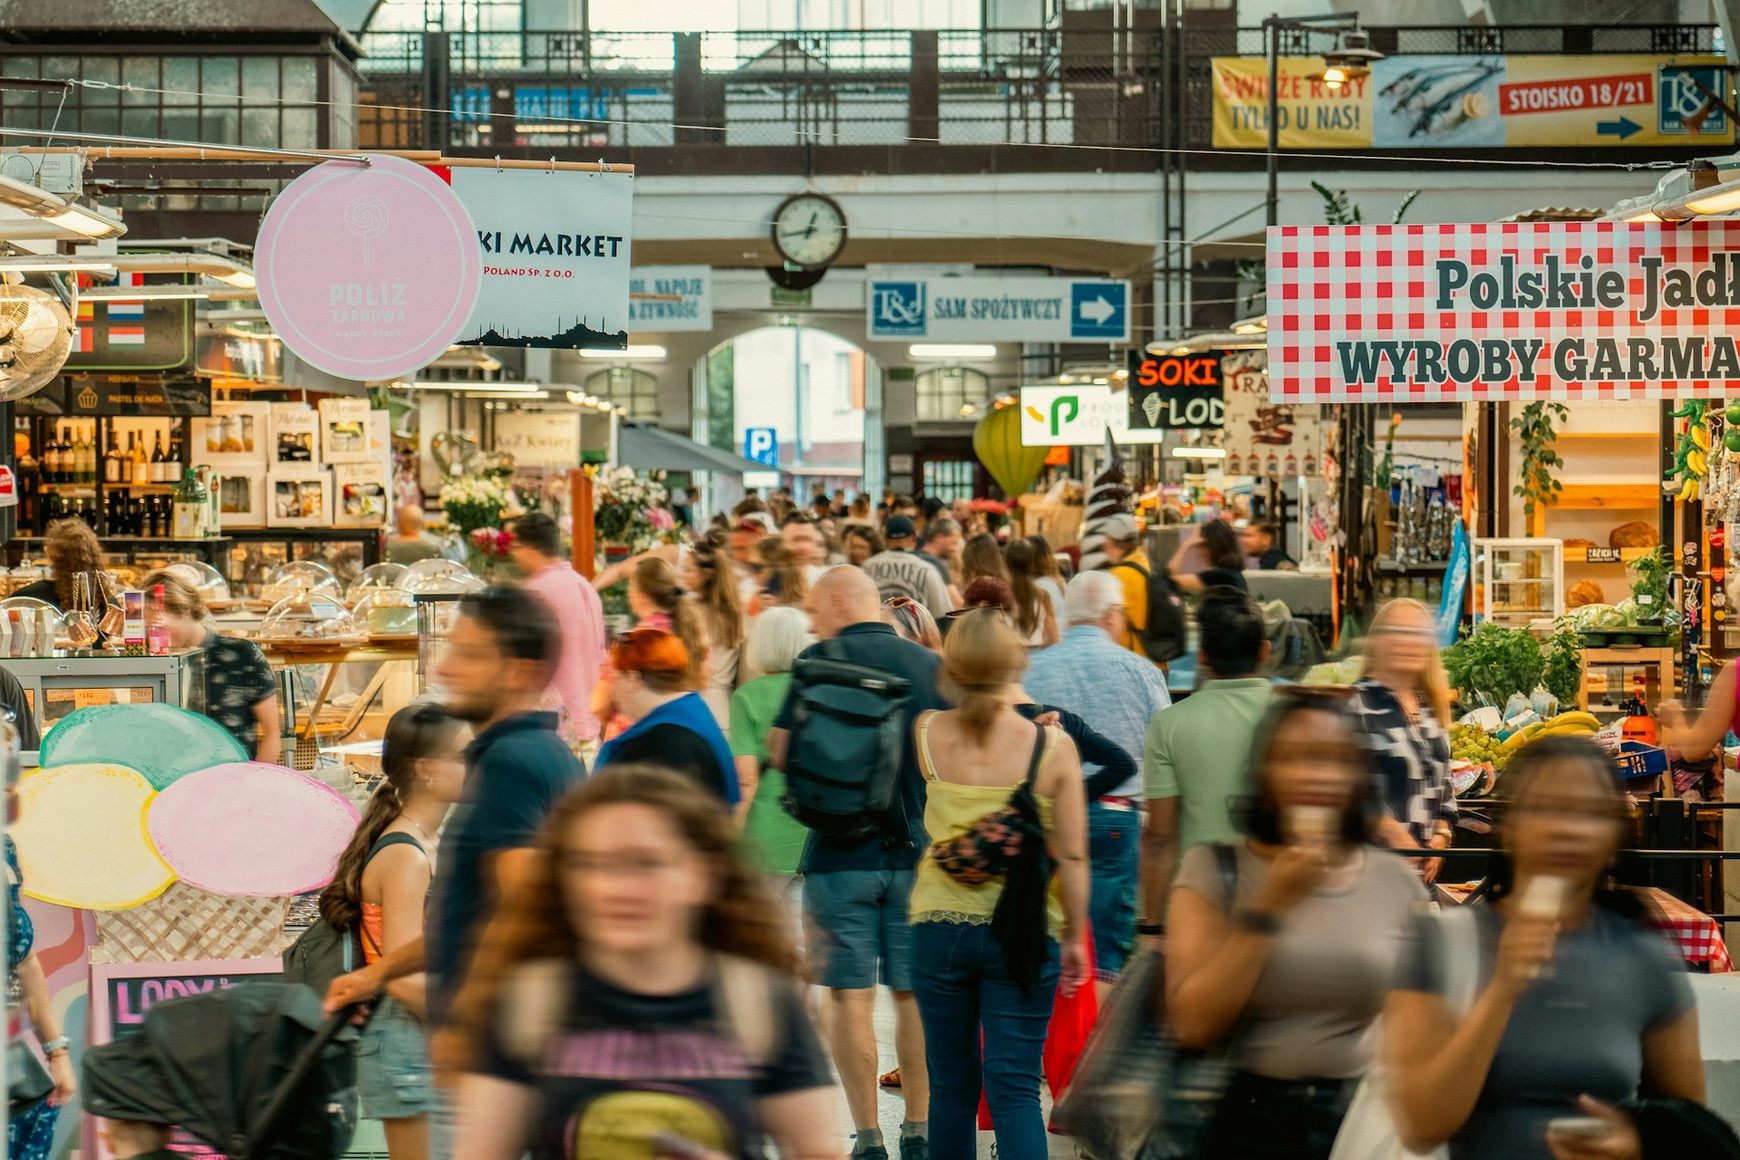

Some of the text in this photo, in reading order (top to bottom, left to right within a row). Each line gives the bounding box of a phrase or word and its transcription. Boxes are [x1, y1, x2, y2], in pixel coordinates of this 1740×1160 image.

[1509, 81, 1645, 111] STOISKO 18/21
[1297, 105, 1309, 131] U
[1317, 105, 1360, 130] NAS!
[509, 233, 623, 257] MARKET
[1436, 255, 1625, 310] Polskie
[330, 309, 407, 322] TARGOWA
[934, 294, 1062, 320] SAM SPOŻYWCZY
[1138, 359, 1217, 387] SOKI
[1337, 337, 1740, 383] WYROBY GARMA
[751, 430, 772, 458] P
